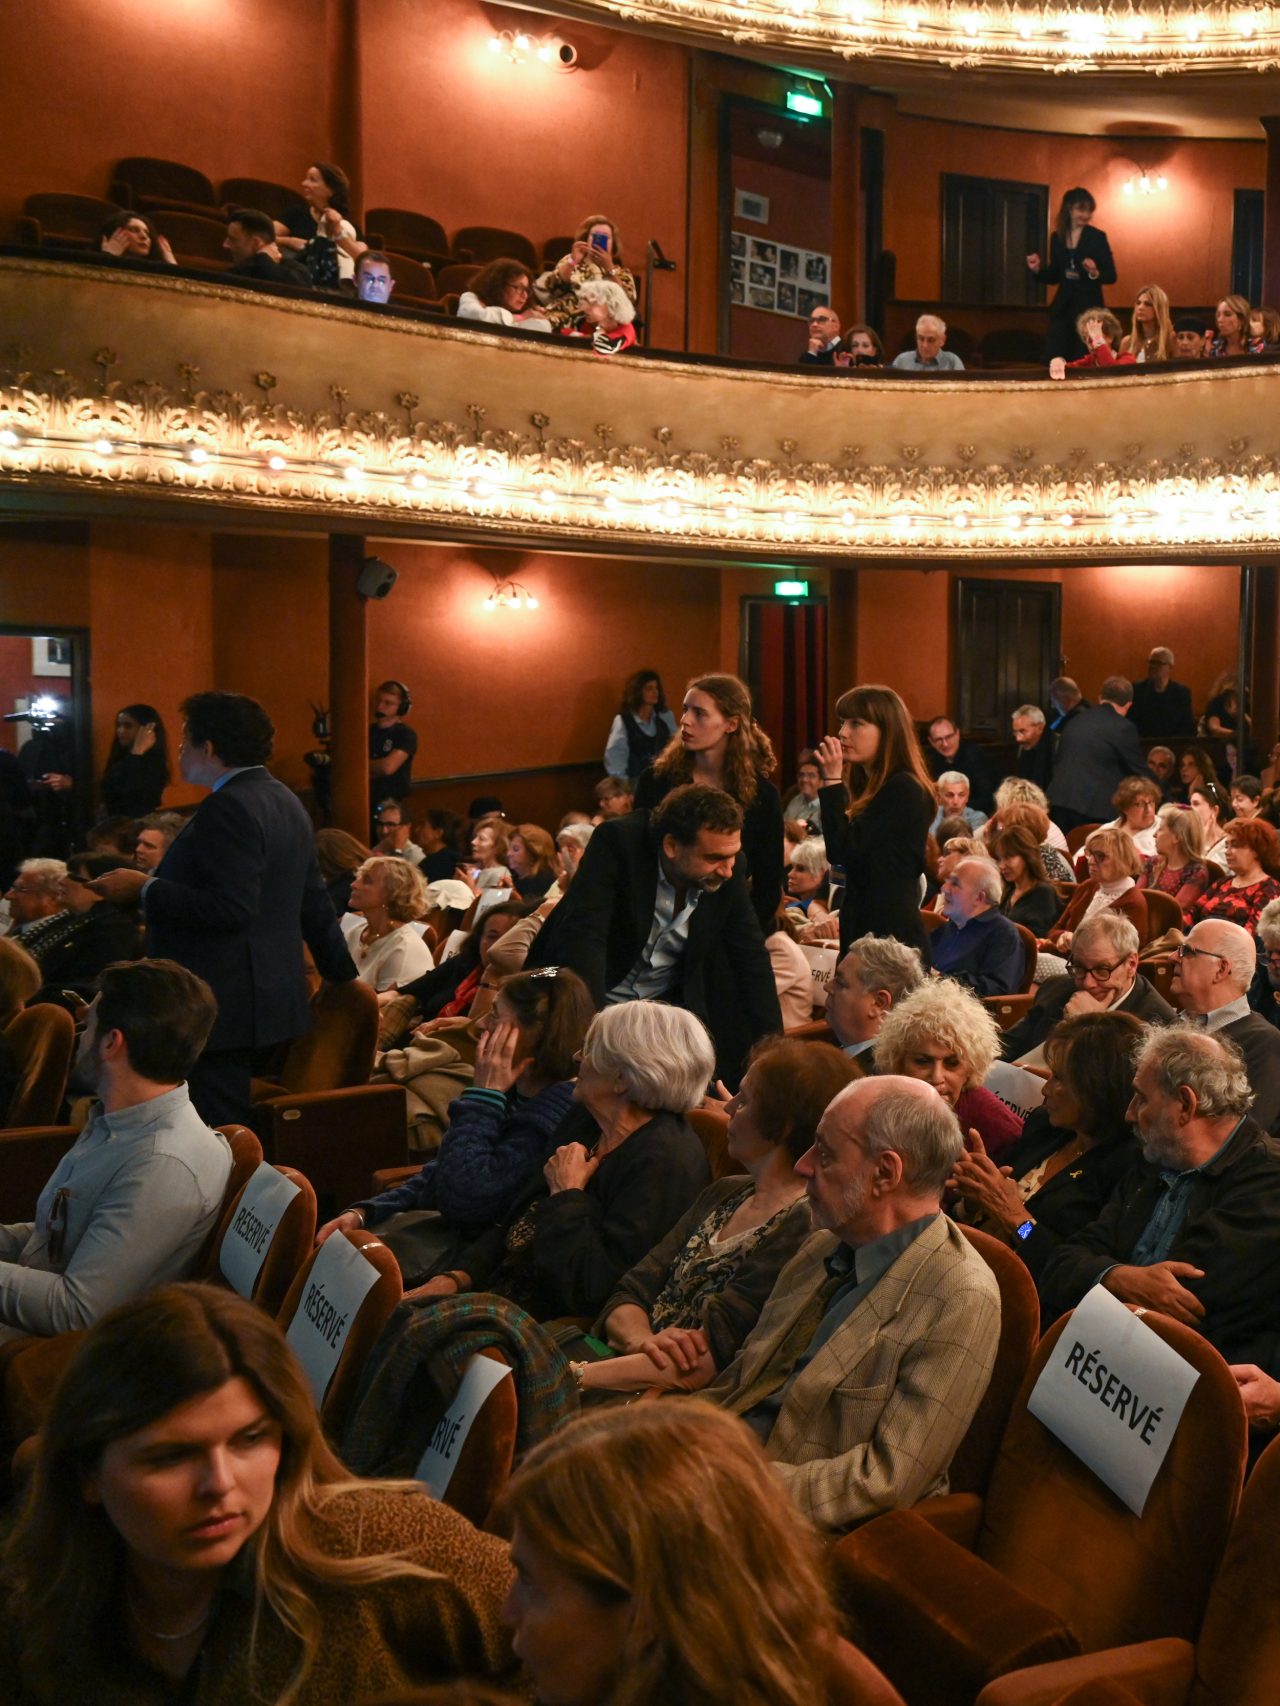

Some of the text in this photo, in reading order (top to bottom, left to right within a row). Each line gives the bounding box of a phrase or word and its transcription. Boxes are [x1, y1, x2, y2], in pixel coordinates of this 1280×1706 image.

[811, 968, 832, 983] ERVÉ
[232, 1206, 274, 1254] RÉSERVÉ
[303, 1283, 349, 1349] RÉSERVÉ
[1064, 1341, 1164, 1446] RÉSERVÉ
